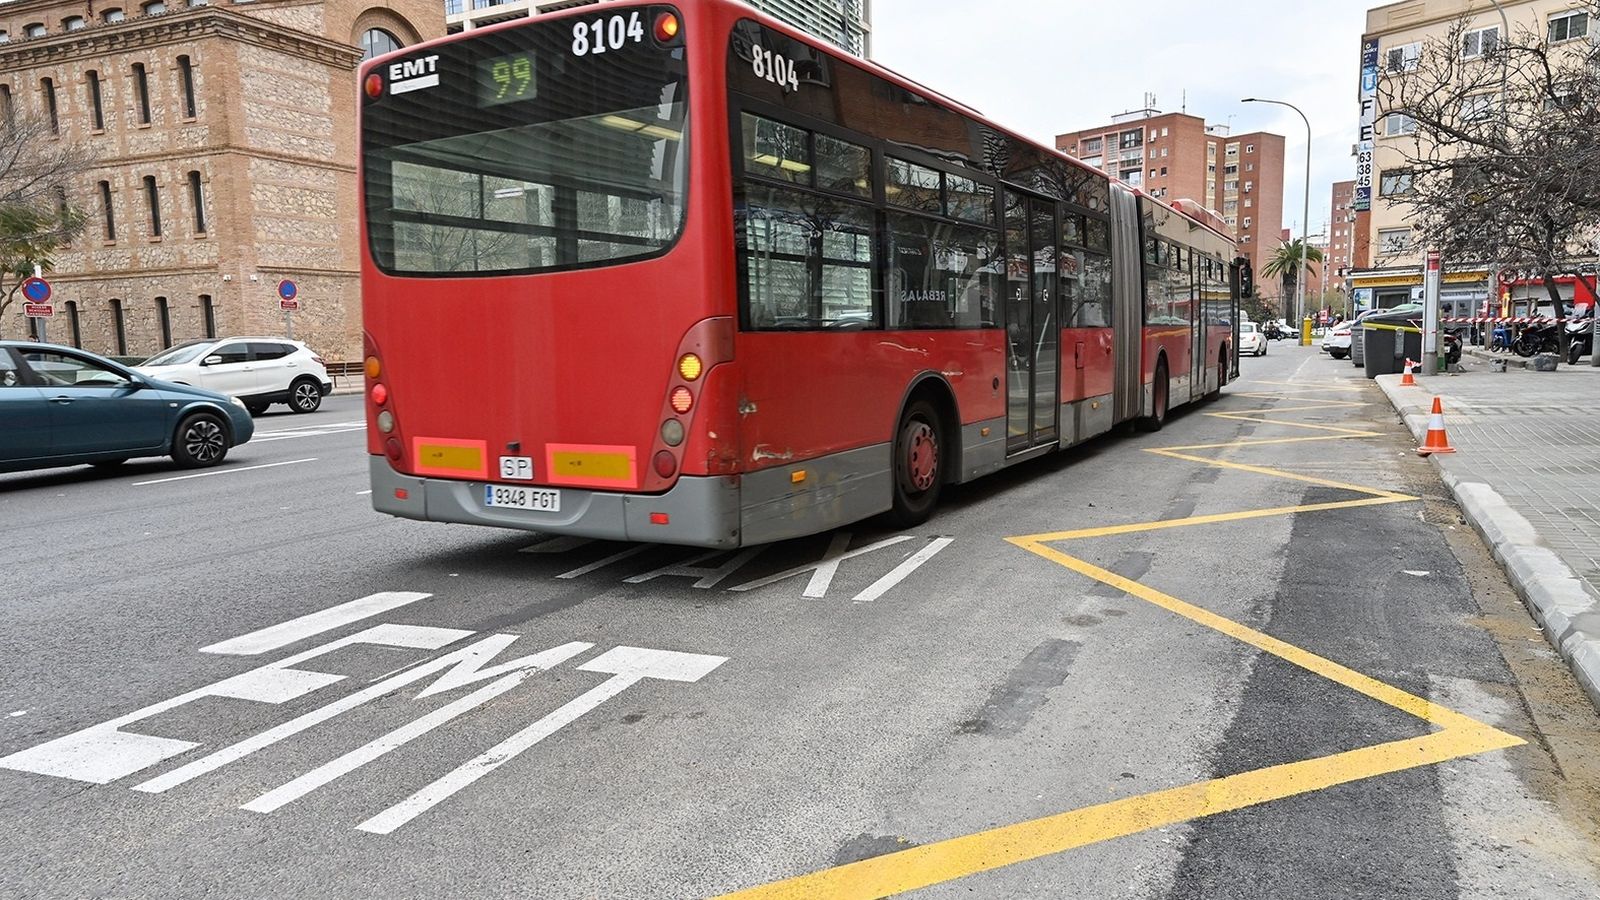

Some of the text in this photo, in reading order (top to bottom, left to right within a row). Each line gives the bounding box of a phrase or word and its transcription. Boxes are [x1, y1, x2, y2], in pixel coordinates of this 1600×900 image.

[572, 11, 643, 56] 8104
[389, 55, 439, 80] EMT
[492, 57, 531, 99] 99
[752, 44, 799, 92] 8104
[1359, 152, 1372, 163] 63
[1358, 164, 1371, 175] 38
[1357, 176, 1370, 187] 45
[504, 459, 529, 476] SP
[495, 488, 557, 509] 9348 FGT
[0, 623, 728, 835] EMT
